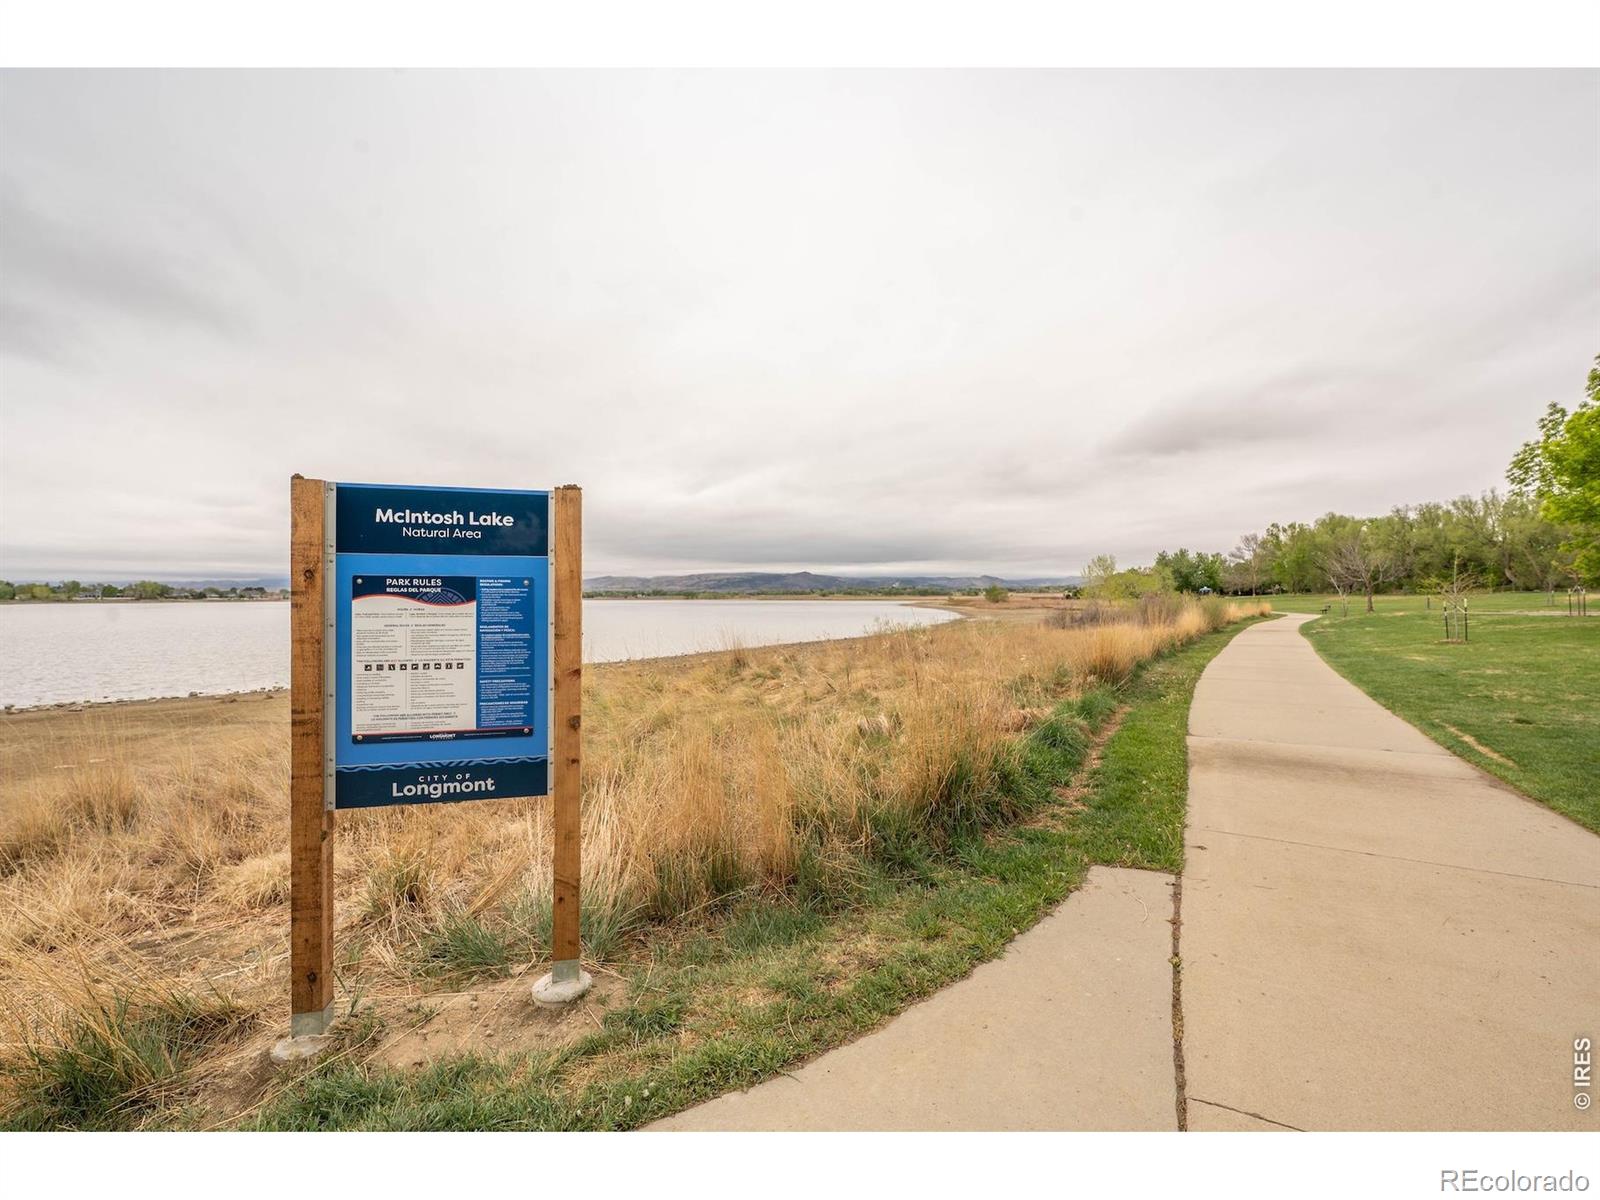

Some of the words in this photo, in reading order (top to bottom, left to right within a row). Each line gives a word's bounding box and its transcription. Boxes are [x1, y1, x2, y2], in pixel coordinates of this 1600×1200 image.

[375, 508, 465, 525] McIntosh
[469, 511, 514, 527] Lake
[402, 527, 450, 538] Natural
[452, 528, 482, 539] Area
[386, 578, 412, 586] PARK
[418, 774, 448, 782] CITY
[392, 777, 496, 798] Longmont
